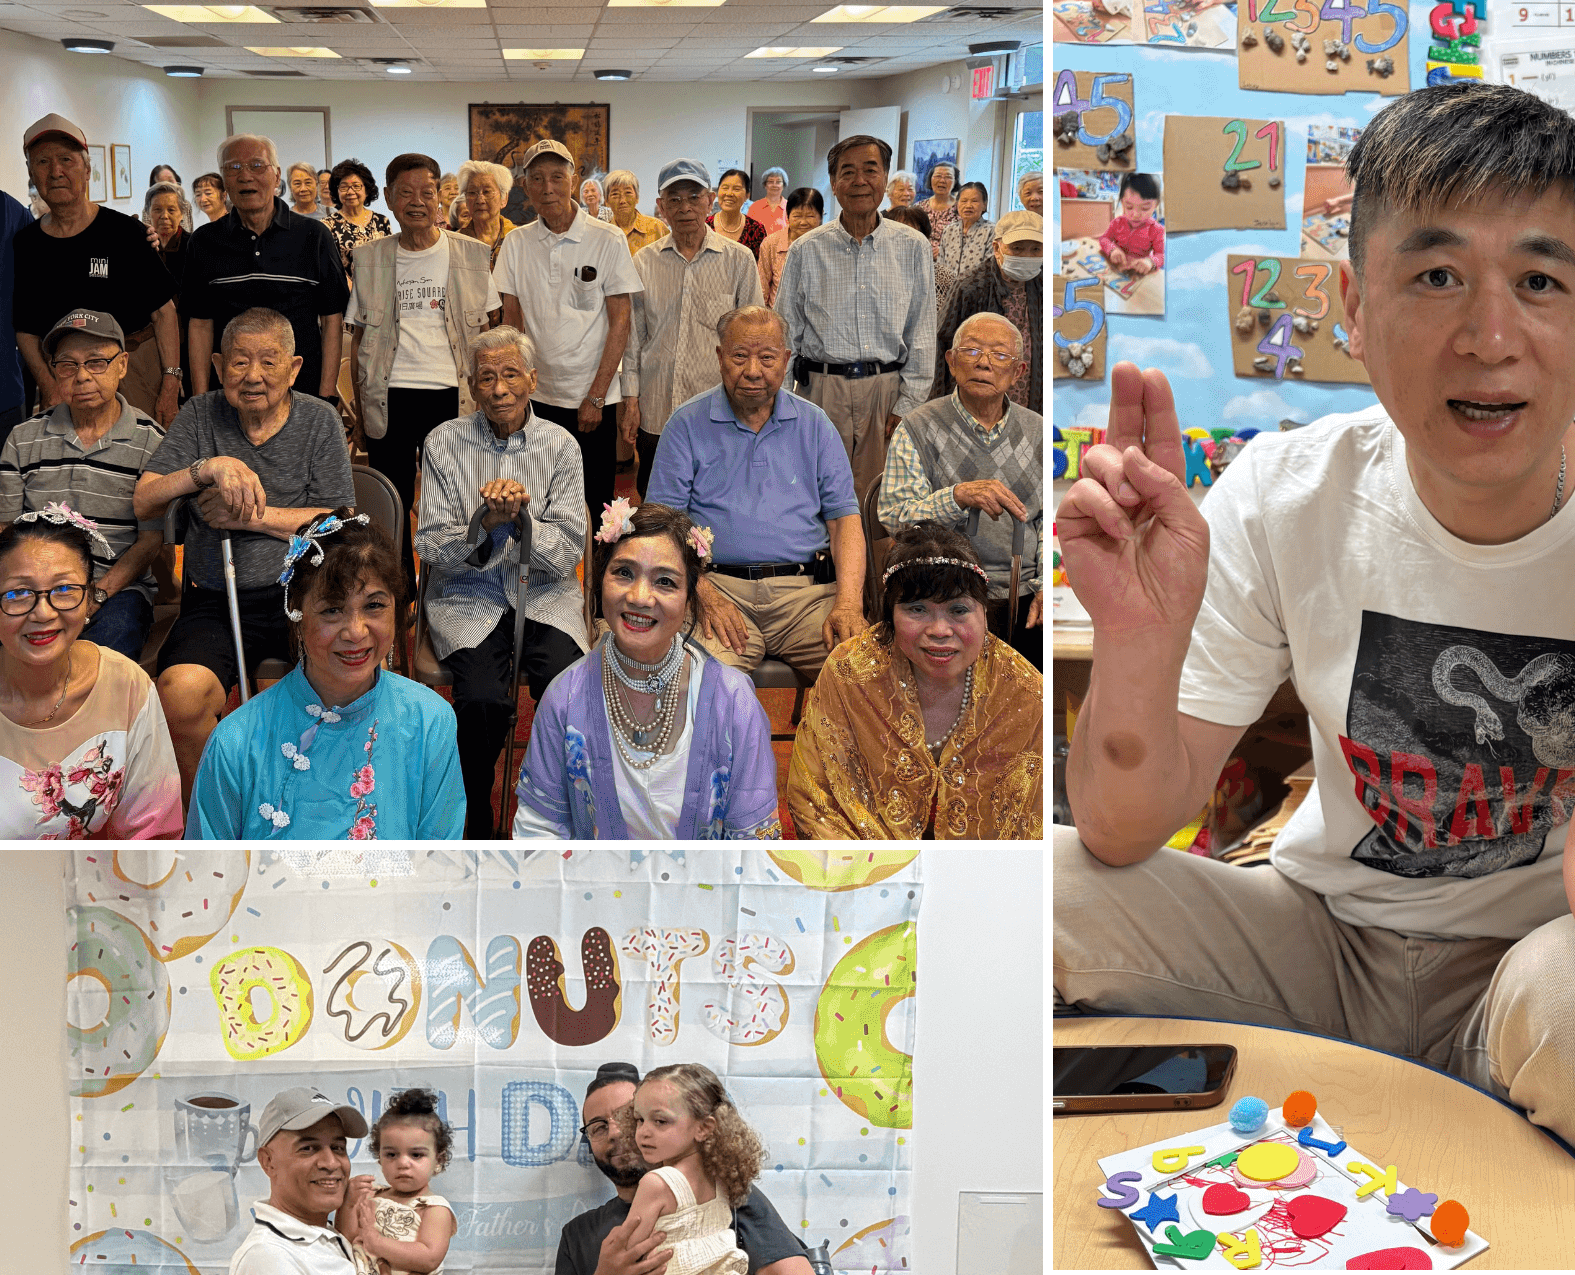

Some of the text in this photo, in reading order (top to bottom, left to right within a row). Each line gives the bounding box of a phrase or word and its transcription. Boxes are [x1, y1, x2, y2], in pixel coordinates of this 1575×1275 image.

[1518, 8, 1529, 22] 9
[1530, 50, 1572, 62] NUMBERS
[89, 262, 109, 276] JAM
[417, 286, 446, 299] SQUARE
[84, 313, 100, 323] CITY
[210, 926, 795, 1060] DONUTS
